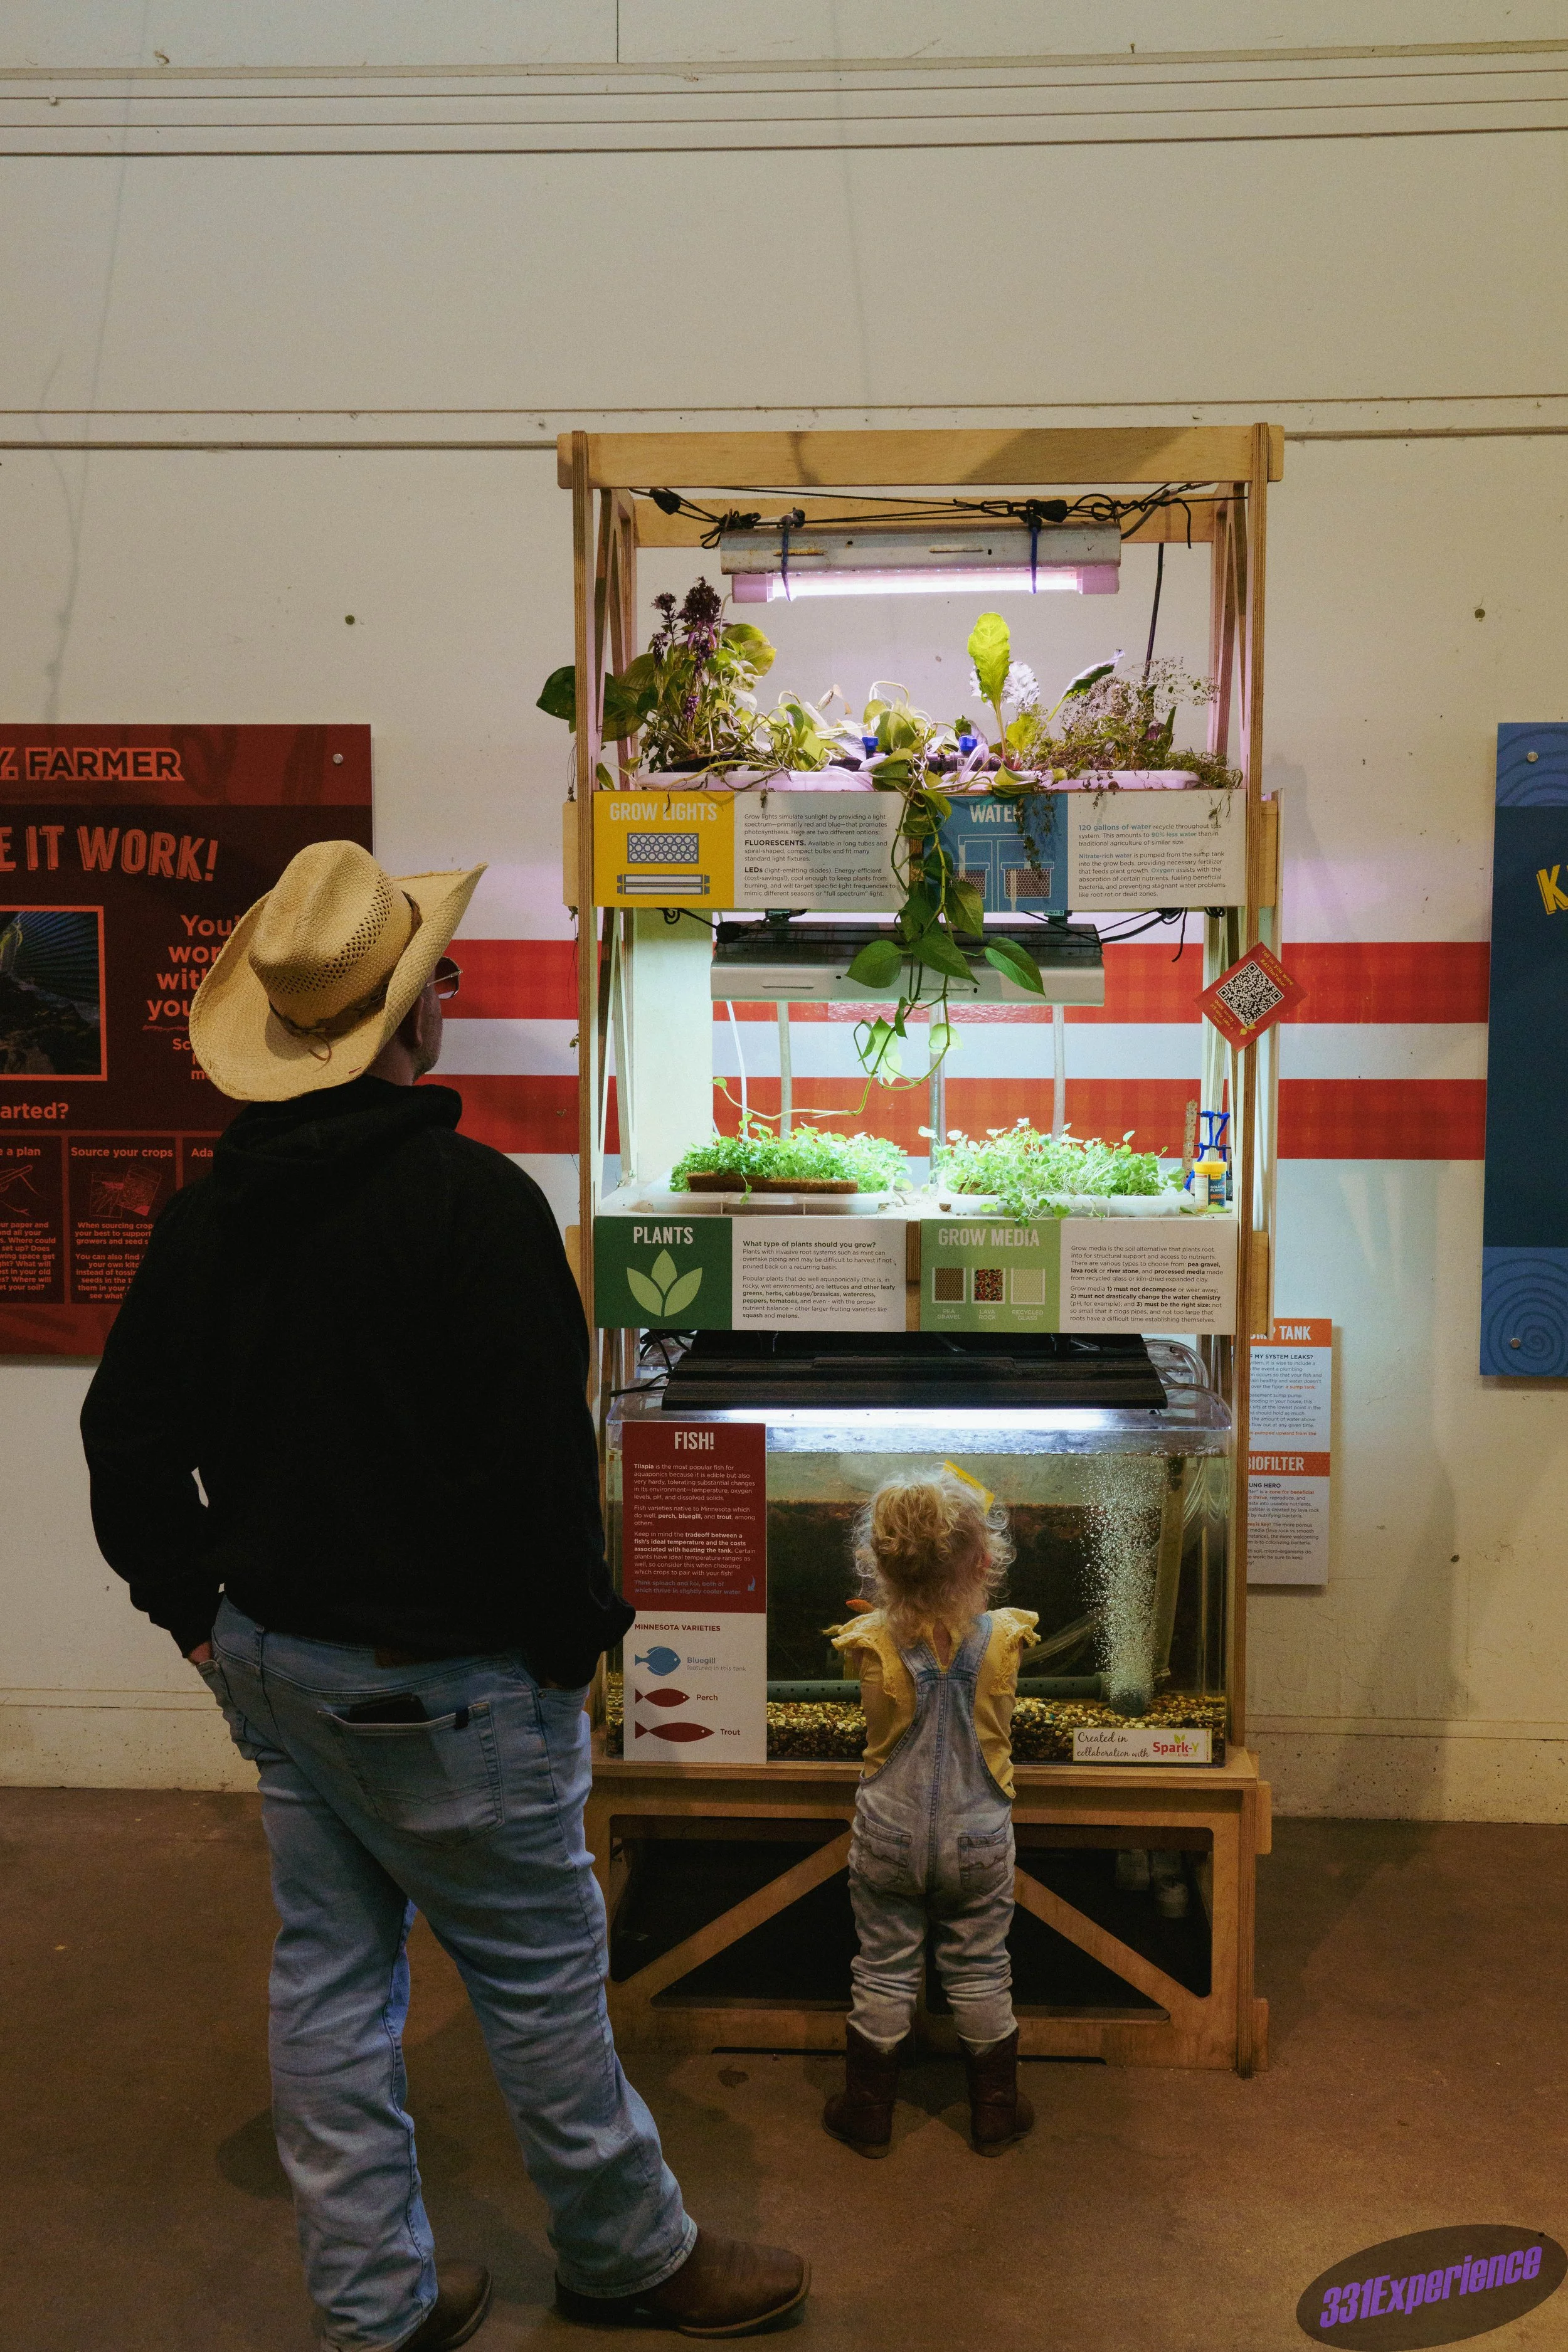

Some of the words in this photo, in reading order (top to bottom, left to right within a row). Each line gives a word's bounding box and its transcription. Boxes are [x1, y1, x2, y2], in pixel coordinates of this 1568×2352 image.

[26, 747, 184, 781] FARMER
[610, 802, 659, 822] GROW
[663, 802, 718, 821] LIGHTS
[1093, 824, 1119, 832] gallons
[1153, 823, 1173, 831] recycle
[1175, 823, 1209, 831] throughout
[26, 825, 64, 871] IT
[77, 826, 218, 883] WORK!
[1140, 852, 1165, 860] pumped
[168, 942, 228, 963] wor
[1262, 950, 1270, 958] Tell
[0, 1103, 69, 1119] arted?
[17, 1147, 41, 1159] plan
[72, 1148, 109, 1157] Source
[114, 1149, 138, 1158] your
[142, 1149, 173, 1158] crops
[191, 1148, 213, 1157] Ada
[102, 1221, 133, 1231] sourcing
[633, 1226, 694, 1244] PLANTS
[938, 1229, 985, 1247] GROW
[991, 1229, 1040, 1247] MEDIA
[790, 1241, 812, 1249] plants
[854, 1241, 876, 1249] grow?
[1154, 1268, 1185, 1276] processed
[785, 1290, 840, 1298] cabbage/brassicas,
[1106, 1293, 1136, 1301] drastically
[1138, 1293, 1159, 1301] change
[1191, 1294, 1221, 1302] chemistry
[1279, 1326, 1311, 1340] TANK
[675, 1431, 714, 1450] FISH!
[678, 1513, 703, 1521] bluegill,
[1078, 1732, 1115, 1742] Created
[1078, 1746, 1130, 1757] collaboration
[1132, 1749, 1150, 1757] with
